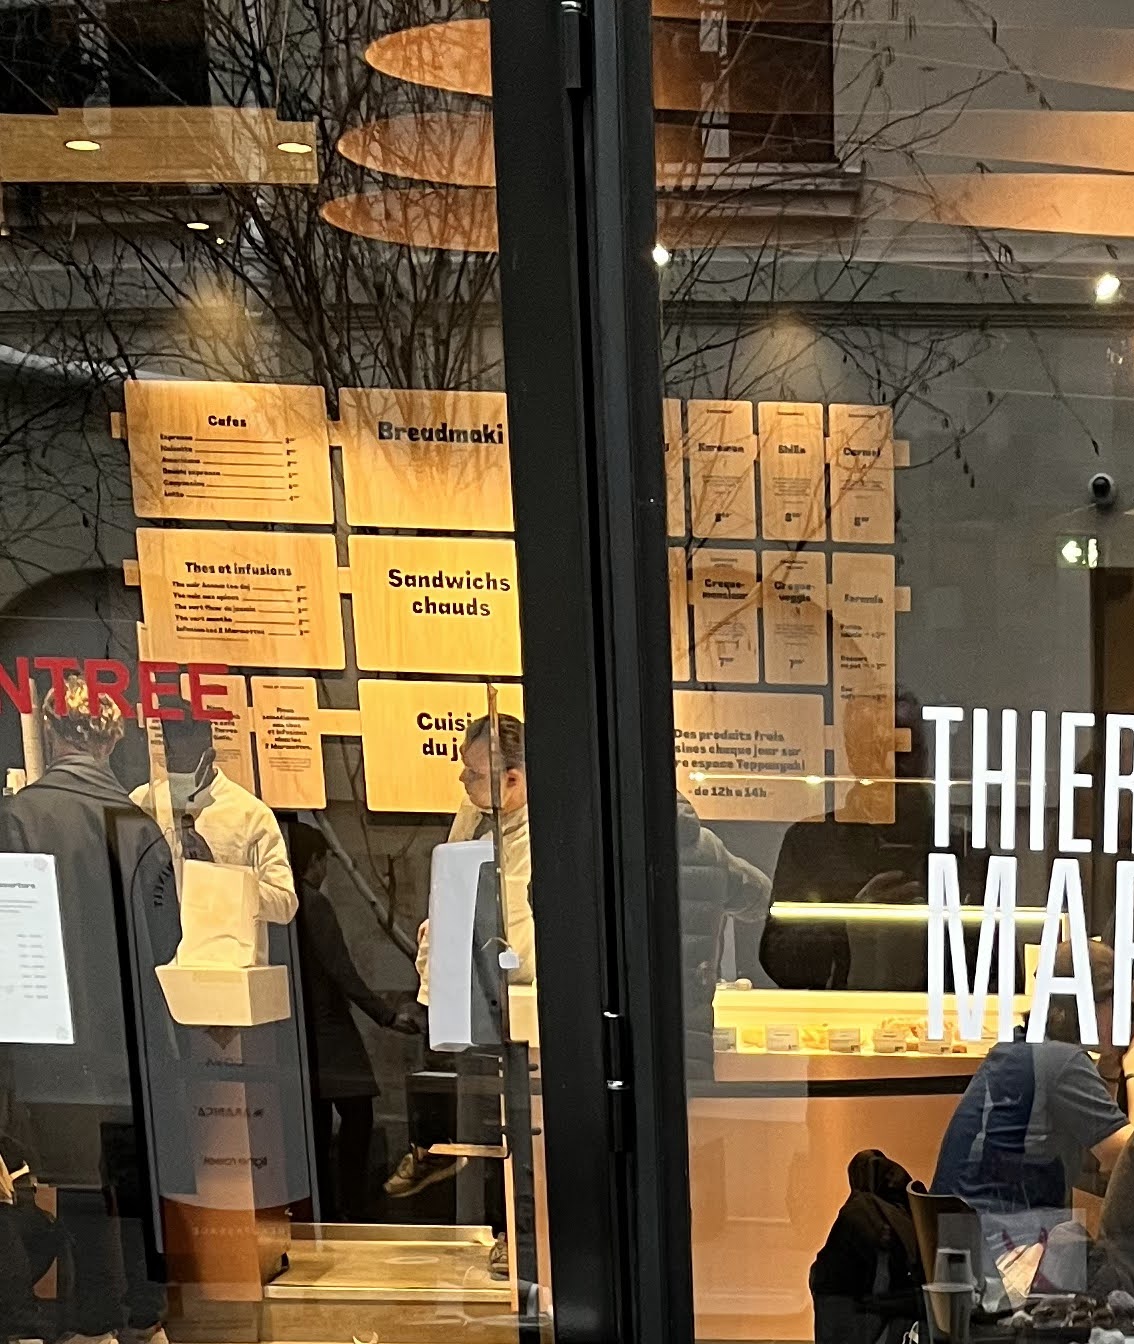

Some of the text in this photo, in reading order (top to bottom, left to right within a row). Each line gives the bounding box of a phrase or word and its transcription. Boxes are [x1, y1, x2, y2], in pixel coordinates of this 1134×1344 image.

[378, 420, 504, 445] Breadmaki
[218, 563, 232, 575] et
[233, 562, 293, 577] infusions
[388, 568, 511, 592] Sandwichs
[412, 596, 491, 617] chauds
[422, 737, 448, 756] du
[694, 786, 708, 796] de
[710, 786, 733, 797] 12h
